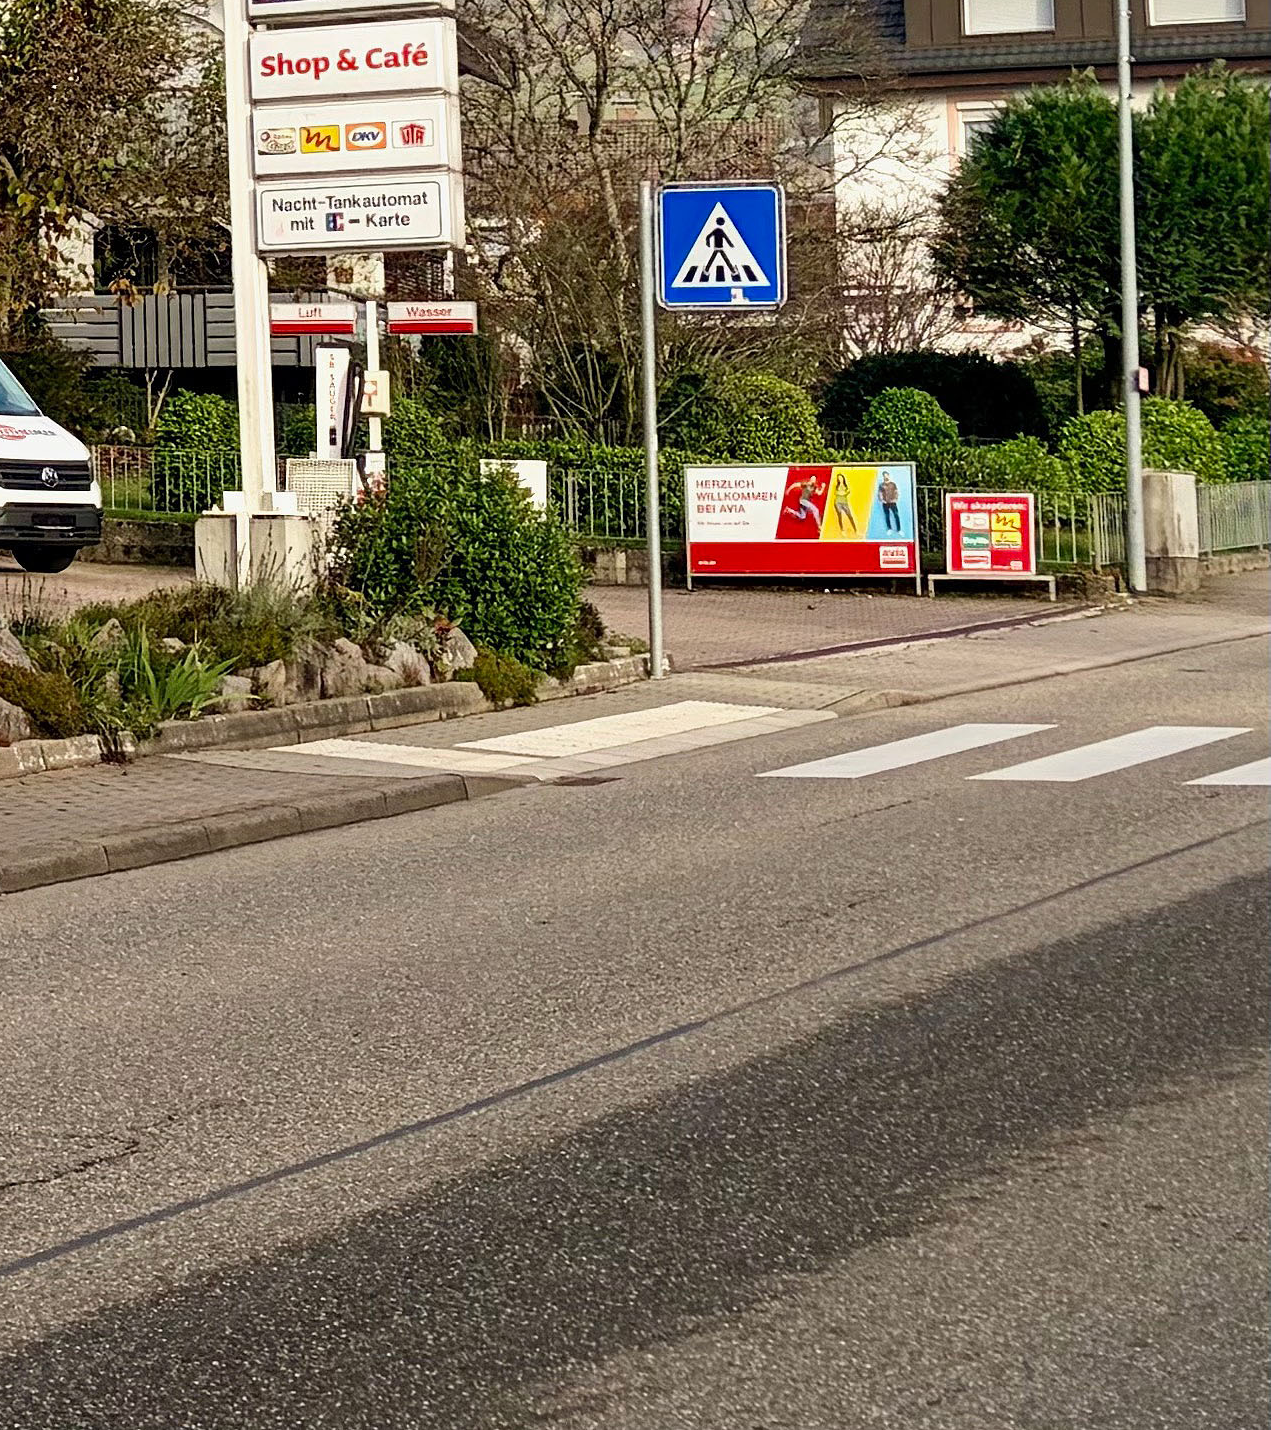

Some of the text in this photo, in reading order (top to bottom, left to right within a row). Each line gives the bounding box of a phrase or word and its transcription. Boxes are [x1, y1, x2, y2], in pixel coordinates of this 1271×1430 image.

[260, 42, 429, 81] Shop & Café
[351, 130, 380, 142] DKV
[271, 191, 428, 213] Nacht-Tankautomat
[290, 217, 315, 231] mit
[365, 213, 411, 228] Karte
[298, 307, 323, 318] Luft
[695, 479, 755, 489] HERZLICH
[696, 492, 778, 501] WILLKOMMEN
[696, 504, 746, 513] BEI AVIA
